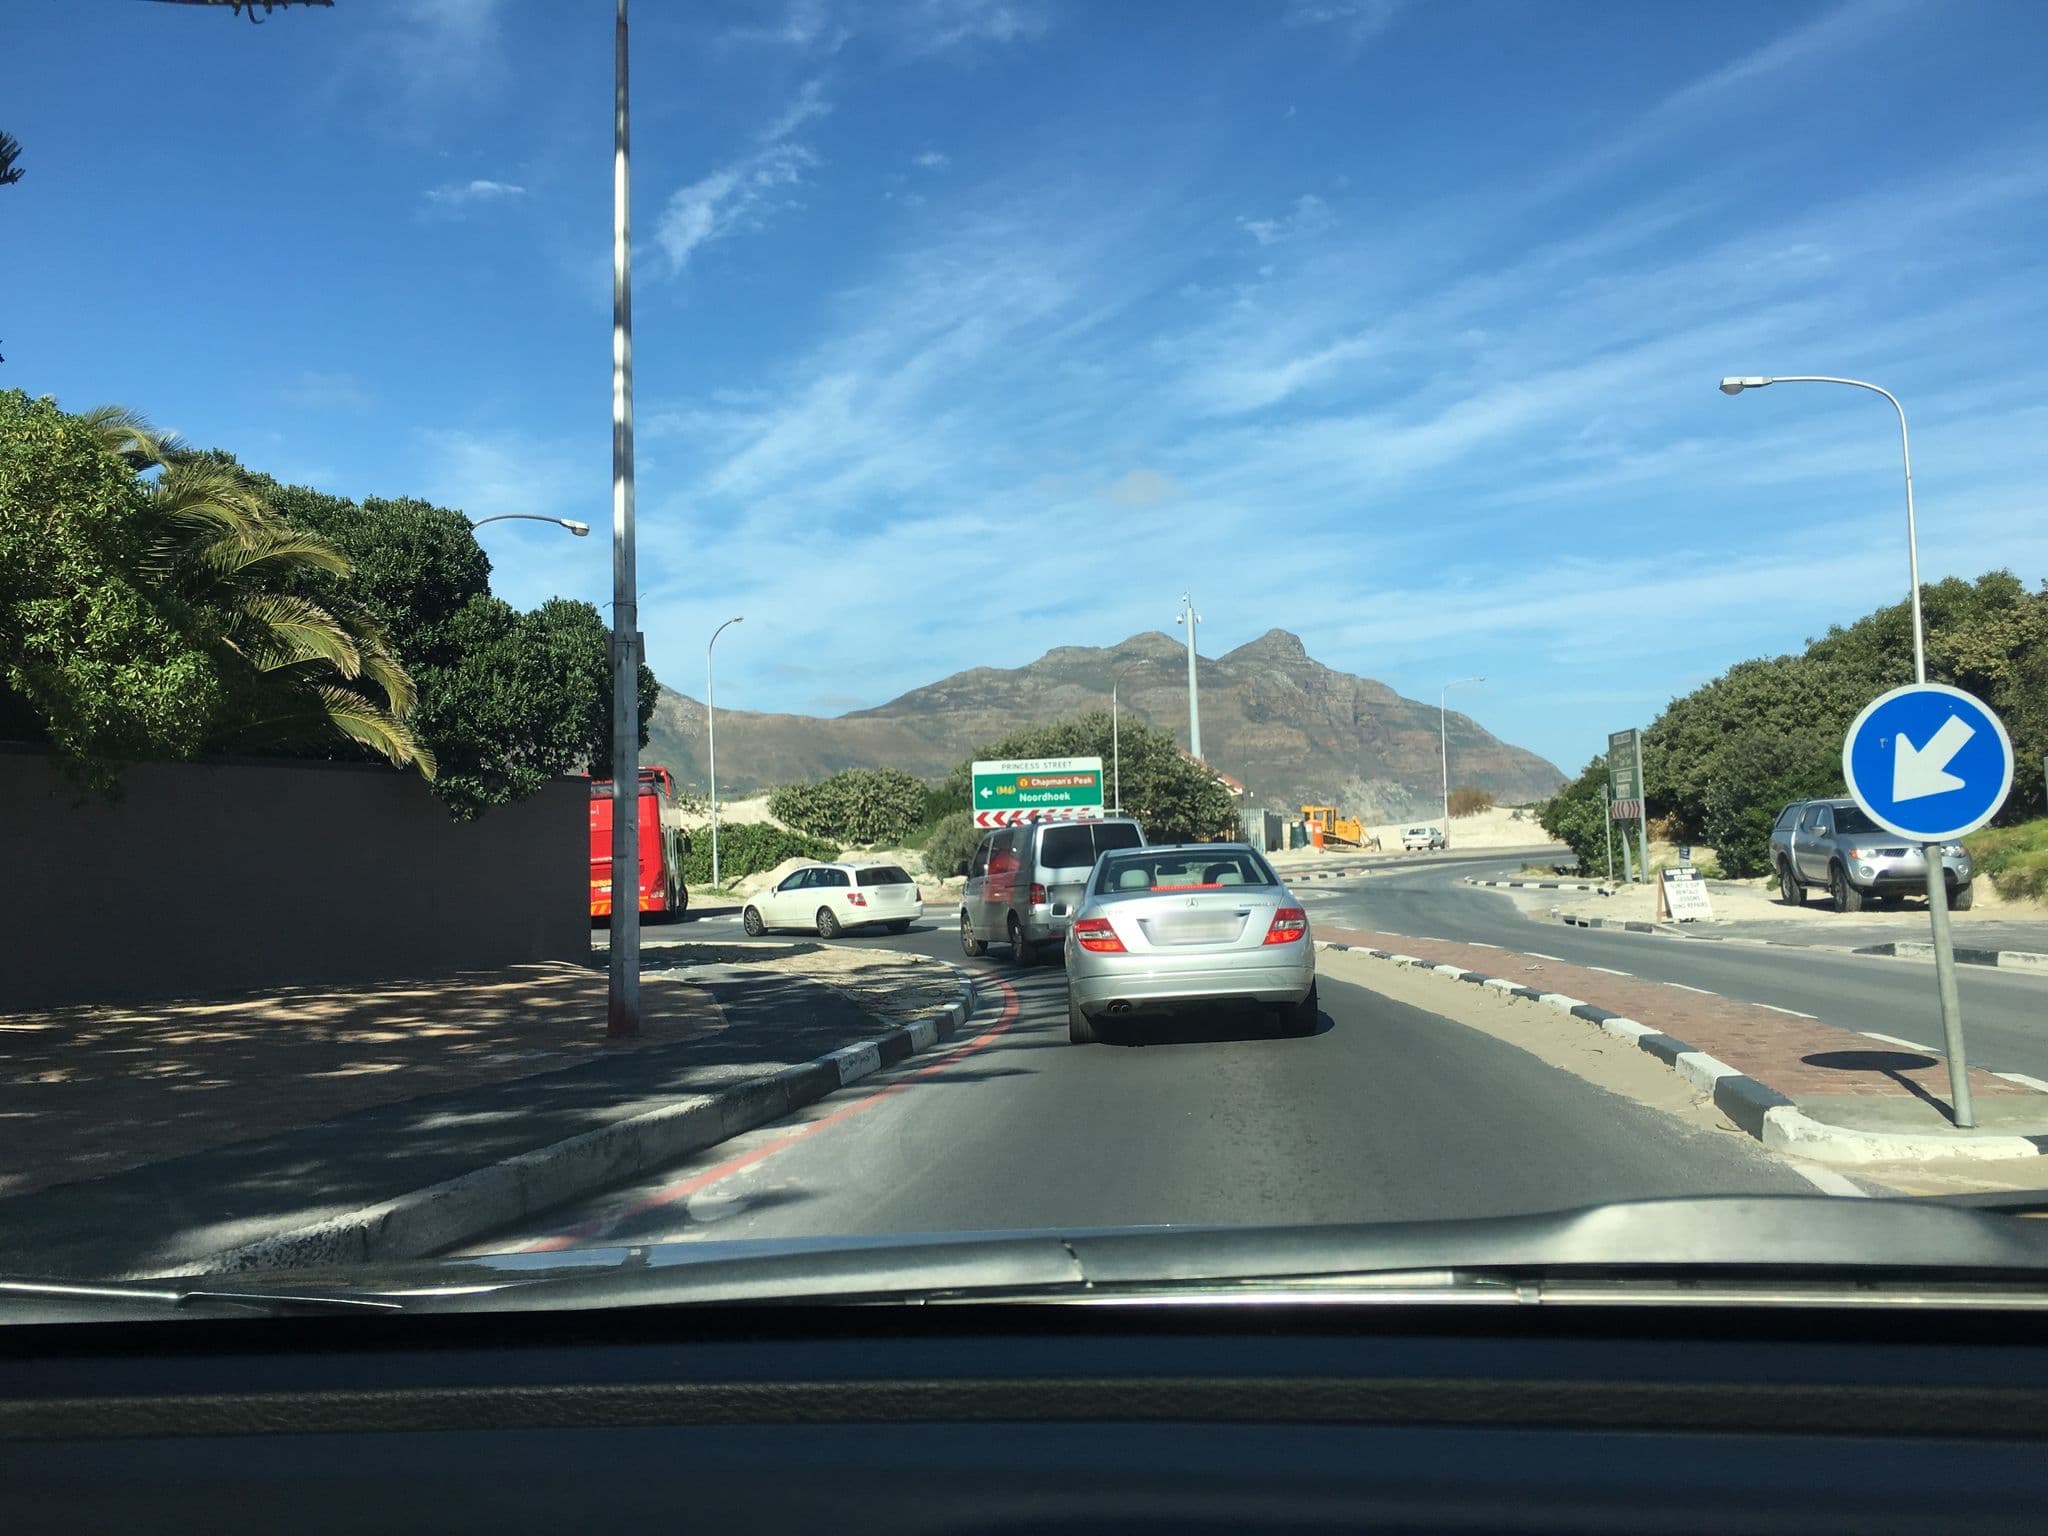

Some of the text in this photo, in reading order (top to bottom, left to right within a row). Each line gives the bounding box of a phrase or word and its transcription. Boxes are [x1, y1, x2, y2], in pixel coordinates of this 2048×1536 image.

[1001, 761, 1072, 770] PRINCESS STREET
[1031, 776, 1092, 787] Chapman's Peak
[1019, 792, 1071, 802] Noordhoek
